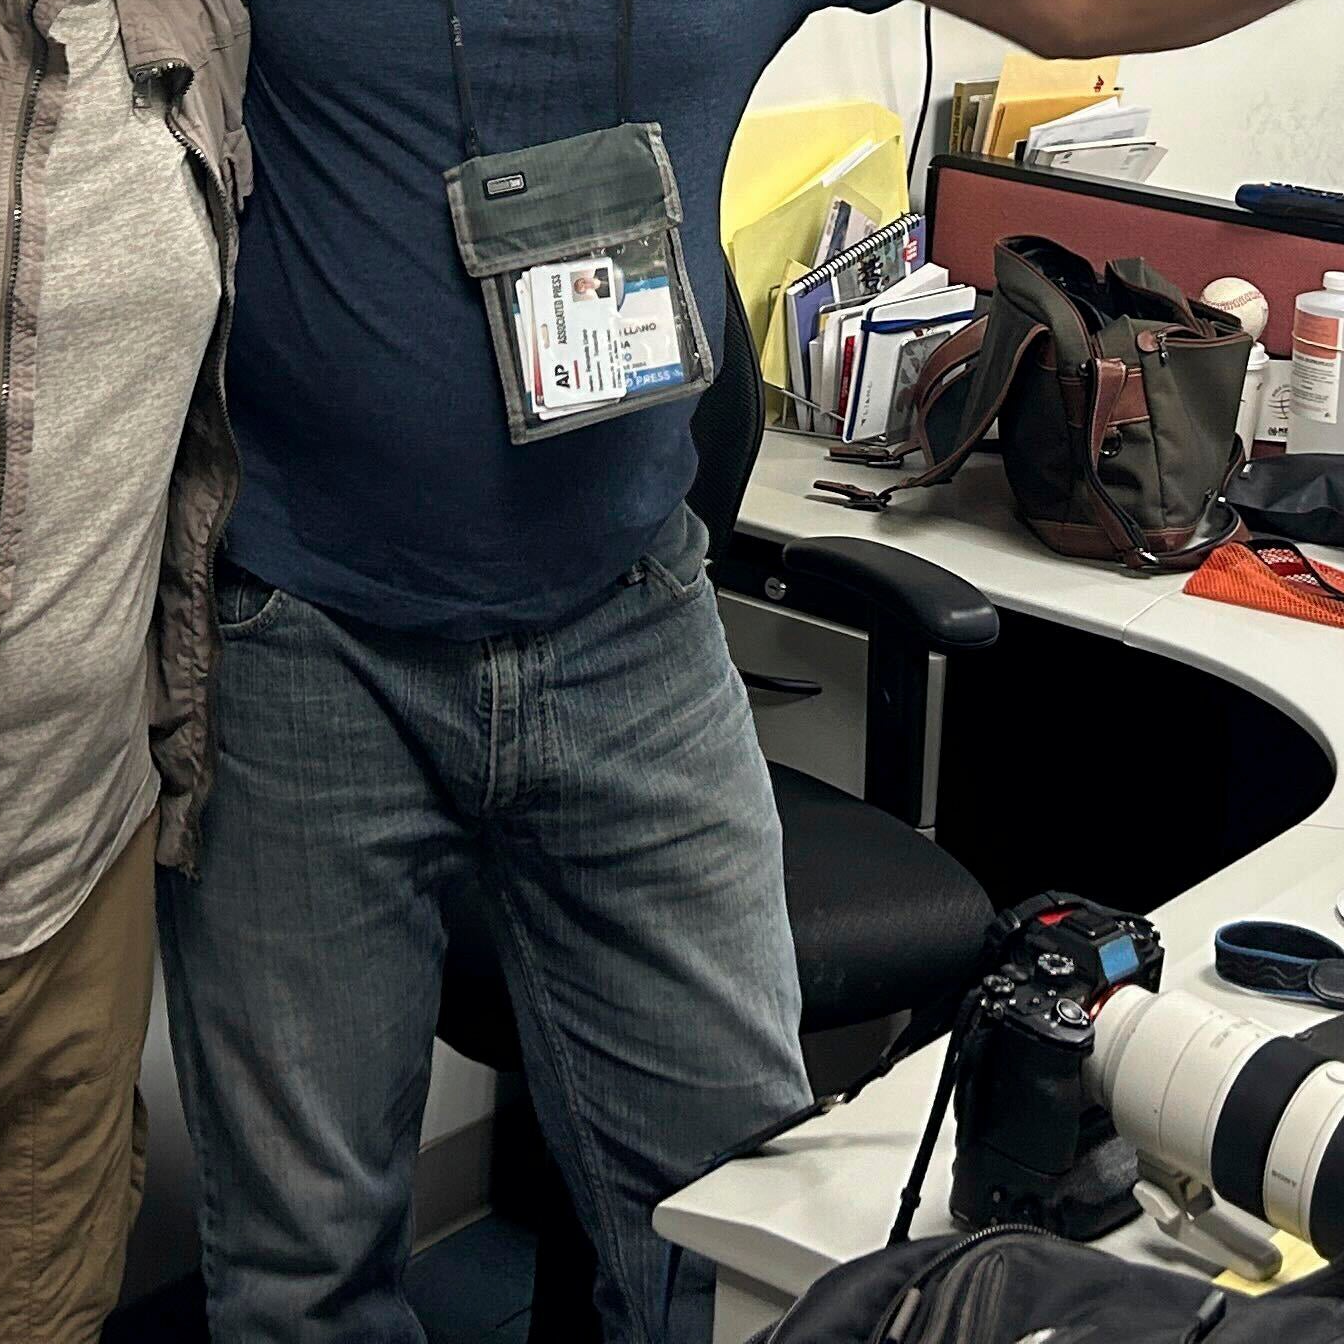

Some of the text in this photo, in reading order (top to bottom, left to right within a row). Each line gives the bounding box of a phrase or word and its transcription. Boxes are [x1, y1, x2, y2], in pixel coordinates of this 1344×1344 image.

[551, 273, 568, 345] ASSOCIATED PRESS
[554, 364, 571, 389] AP
